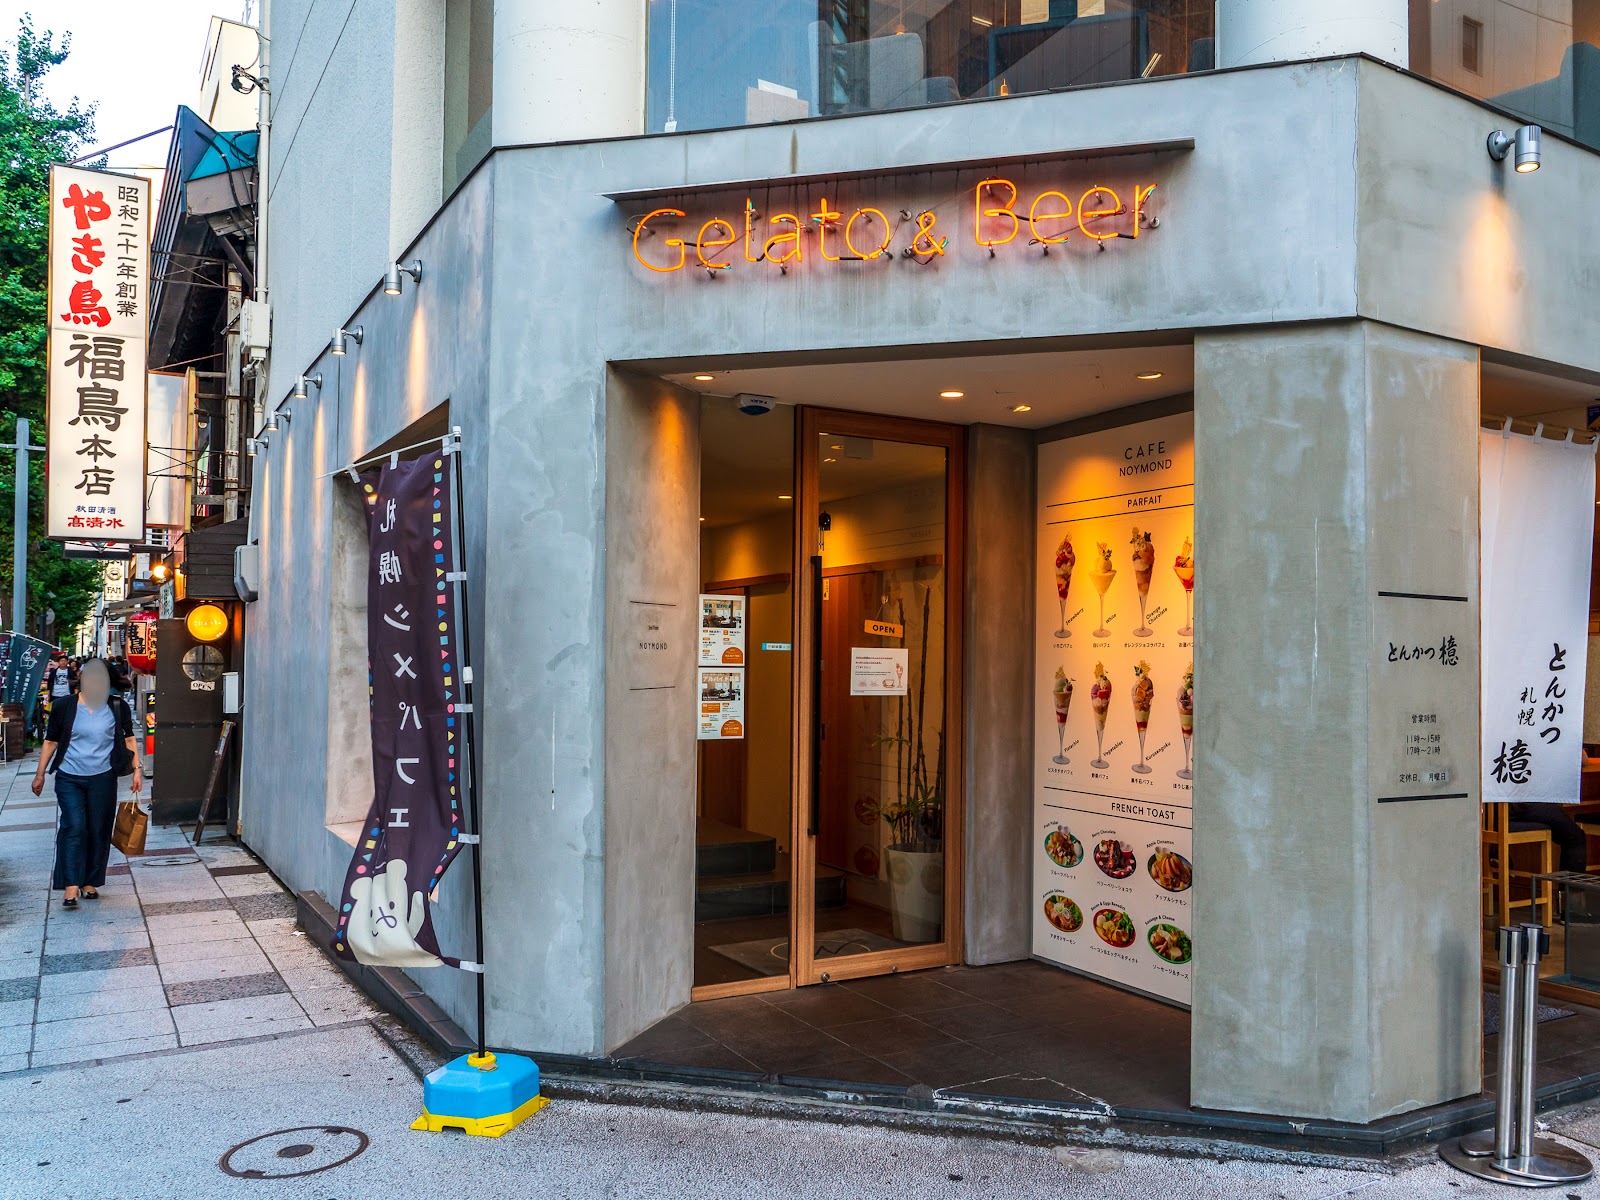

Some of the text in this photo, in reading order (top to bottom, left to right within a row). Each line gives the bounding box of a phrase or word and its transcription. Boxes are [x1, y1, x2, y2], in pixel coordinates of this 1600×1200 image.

[633, 178, 1159, 273] Gelato & Beer
[61, 183, 112, 328] やき鳥
[115, 185, 140, 318] 昭和二十一年創業
[64, 333, 129, 496] 福鳥本店
[1124, 440, 1166, 460] CAFE
[1119, 459, 1172, 477] NOYMOND
[75, 504, 116, 515] 秋田清酒
[1127, 494, 1162, 508] PARFAIT
[107, 586, 122, 594] FAM
[1145, 606, 1161, 620] Orange
[1148, 607, 1168, 625] Chocolate
[872, 624, 896, 634] OPEN
[639, 642, 668, 650] NOYMOND
[192, 682, 212, 690] OPEN
[1539, 642, 1567, 745] とんかつ
[1516, 687, 1537, 727] 札幌
[1411, 714, 1437, 724] 営業時間
[1111, 802, 1175, 821] FRENCH TOAST
